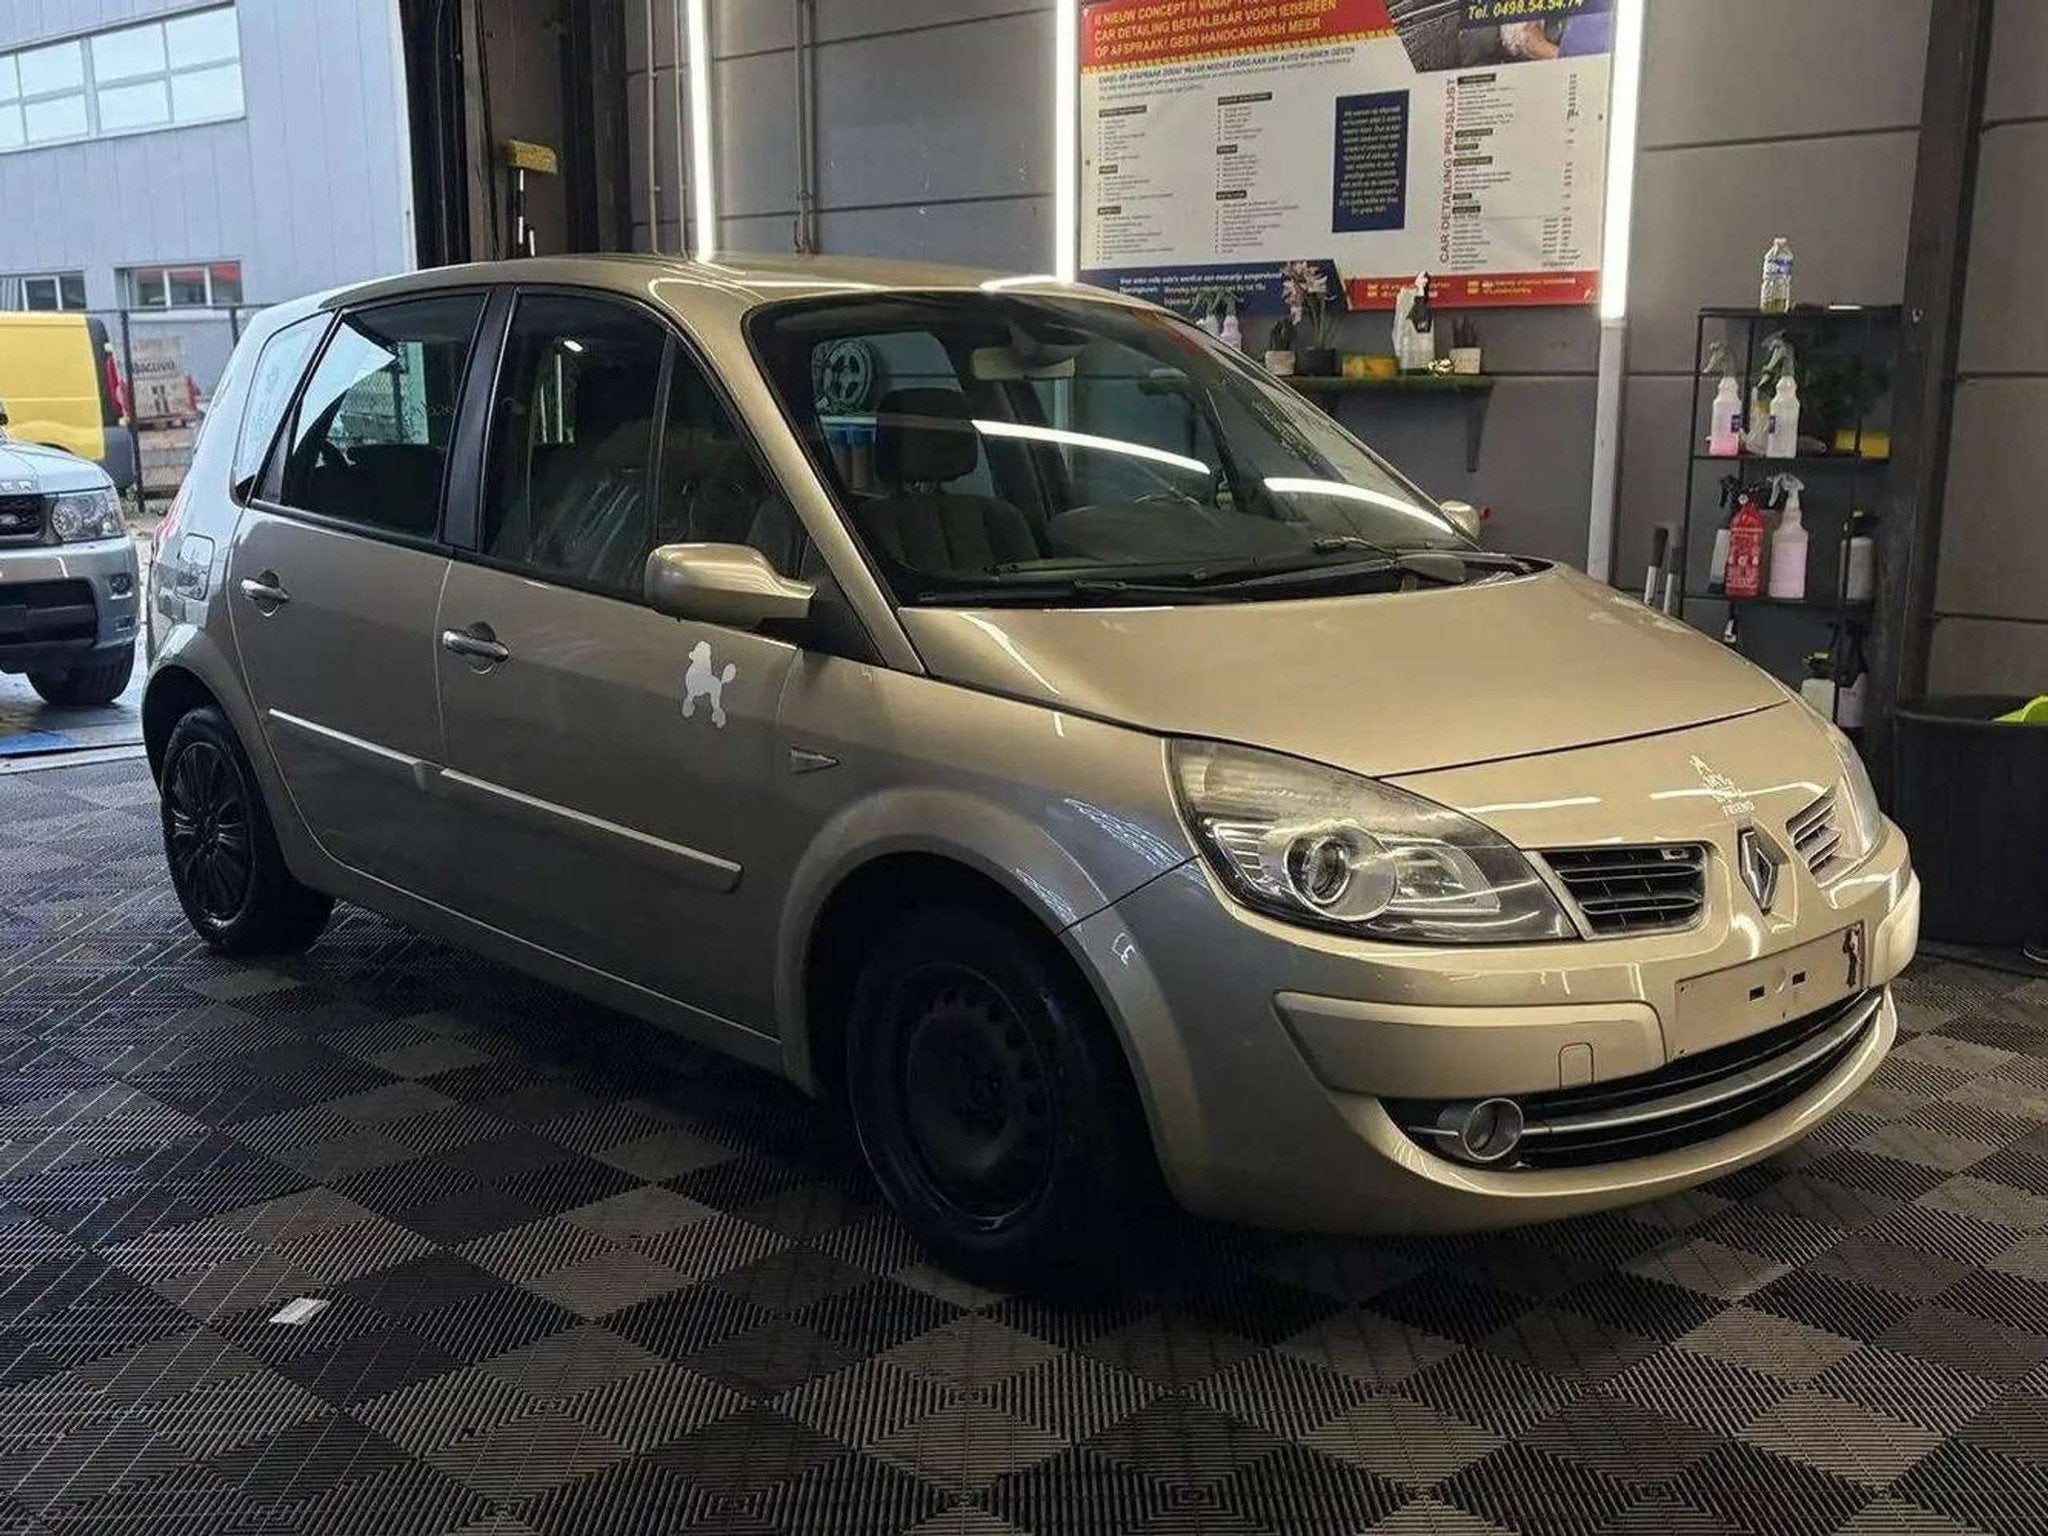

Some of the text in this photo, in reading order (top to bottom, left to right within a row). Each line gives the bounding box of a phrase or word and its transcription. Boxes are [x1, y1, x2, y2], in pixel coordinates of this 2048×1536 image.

[1094, 27, 1117, 42] CAR
[1118, 21, 1170, 39] DETAILING
[1172, 9, 1243, 33] BETAALBAAR
[1244, 5, 1277, 21] VOOR
[1279, 0, 1337, 17] IEDEREEN
[1103, 9, 1136, 24] NIEUW
[1137, 3, 1185, 20] CONCEPT
[1468, 6, 1489, 20] Tel.
[1094, 44, 1110, 58] OP
[1169, 35, 1199, 49] GEEN
[1200, 21, 1286, 43] HANDCARWASH
[1287, 17, 1321, 33] MEER
[1440, 79, 1456, 264] CAR DETAILING PRIJSLIJST
